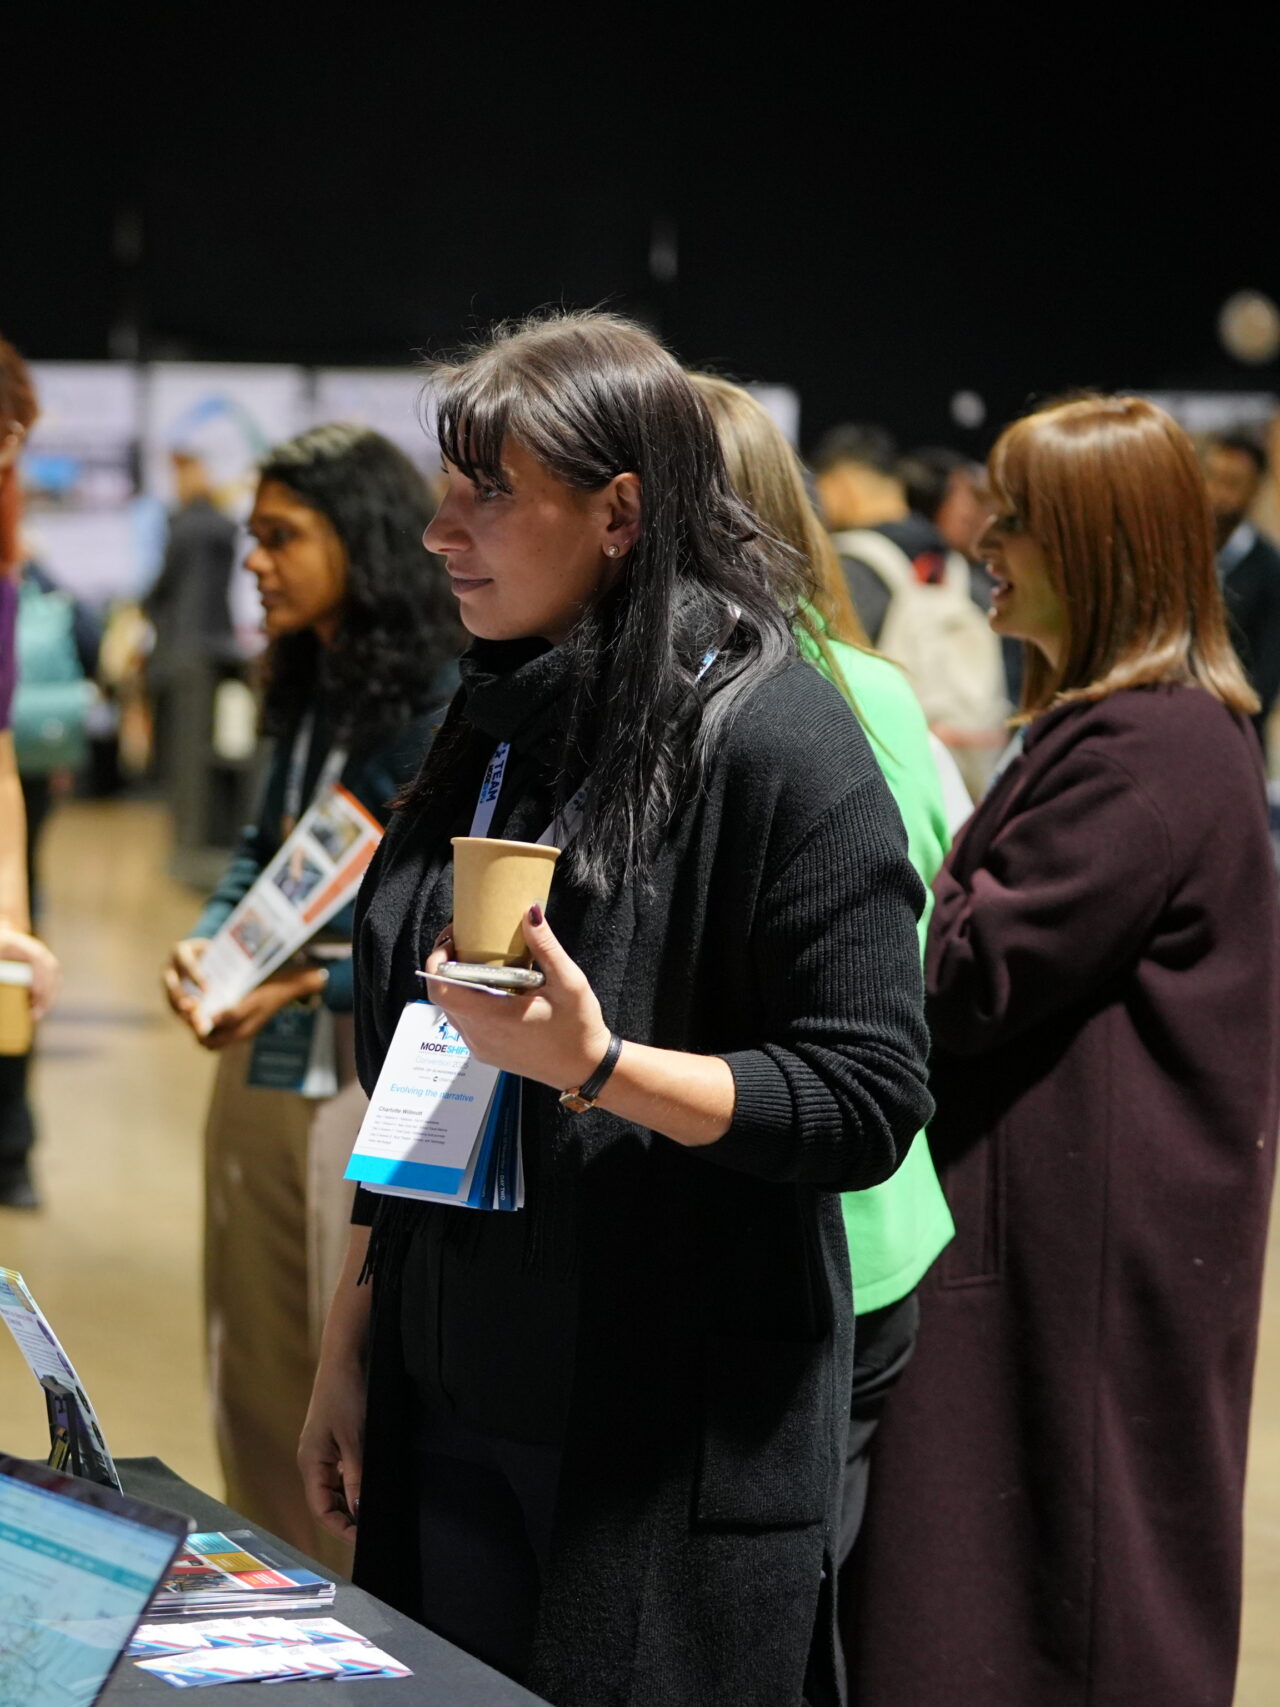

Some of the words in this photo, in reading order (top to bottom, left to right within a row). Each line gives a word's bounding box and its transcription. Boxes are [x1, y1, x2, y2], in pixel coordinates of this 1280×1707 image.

[486, 760, 505, 802] TEAM
[390, 1083, 423, 1097] Evolving
[424, 1088, 438, 1097] the
[440, 1091, 475, 1103] narrative
